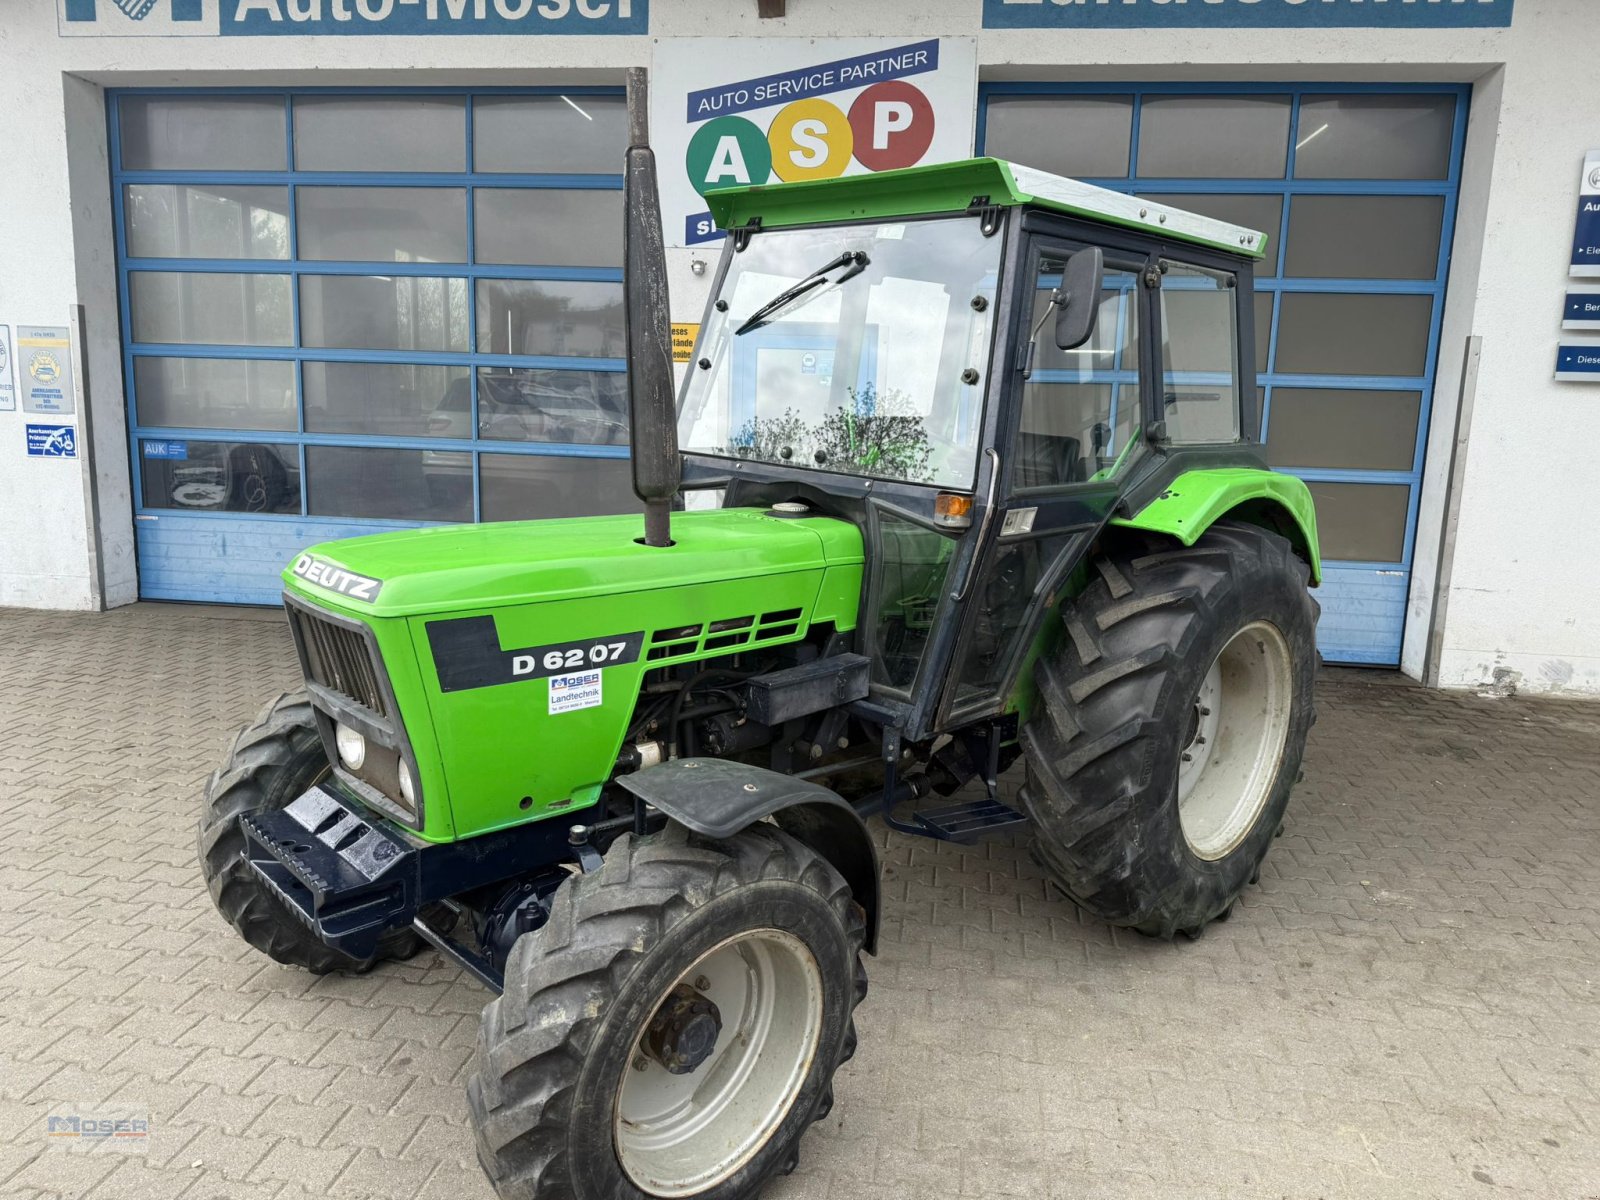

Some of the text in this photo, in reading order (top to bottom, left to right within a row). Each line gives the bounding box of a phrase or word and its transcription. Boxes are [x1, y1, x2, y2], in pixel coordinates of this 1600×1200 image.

[698, 50, 928, 113] AUTO SERVICE PARTNER
[293, 555, 379, 600] DEUTZ
[512, 655, 536, 676] D
[551, 673, 599, 688] MOSER
[551, 688, 600, 704] Landtechnik
